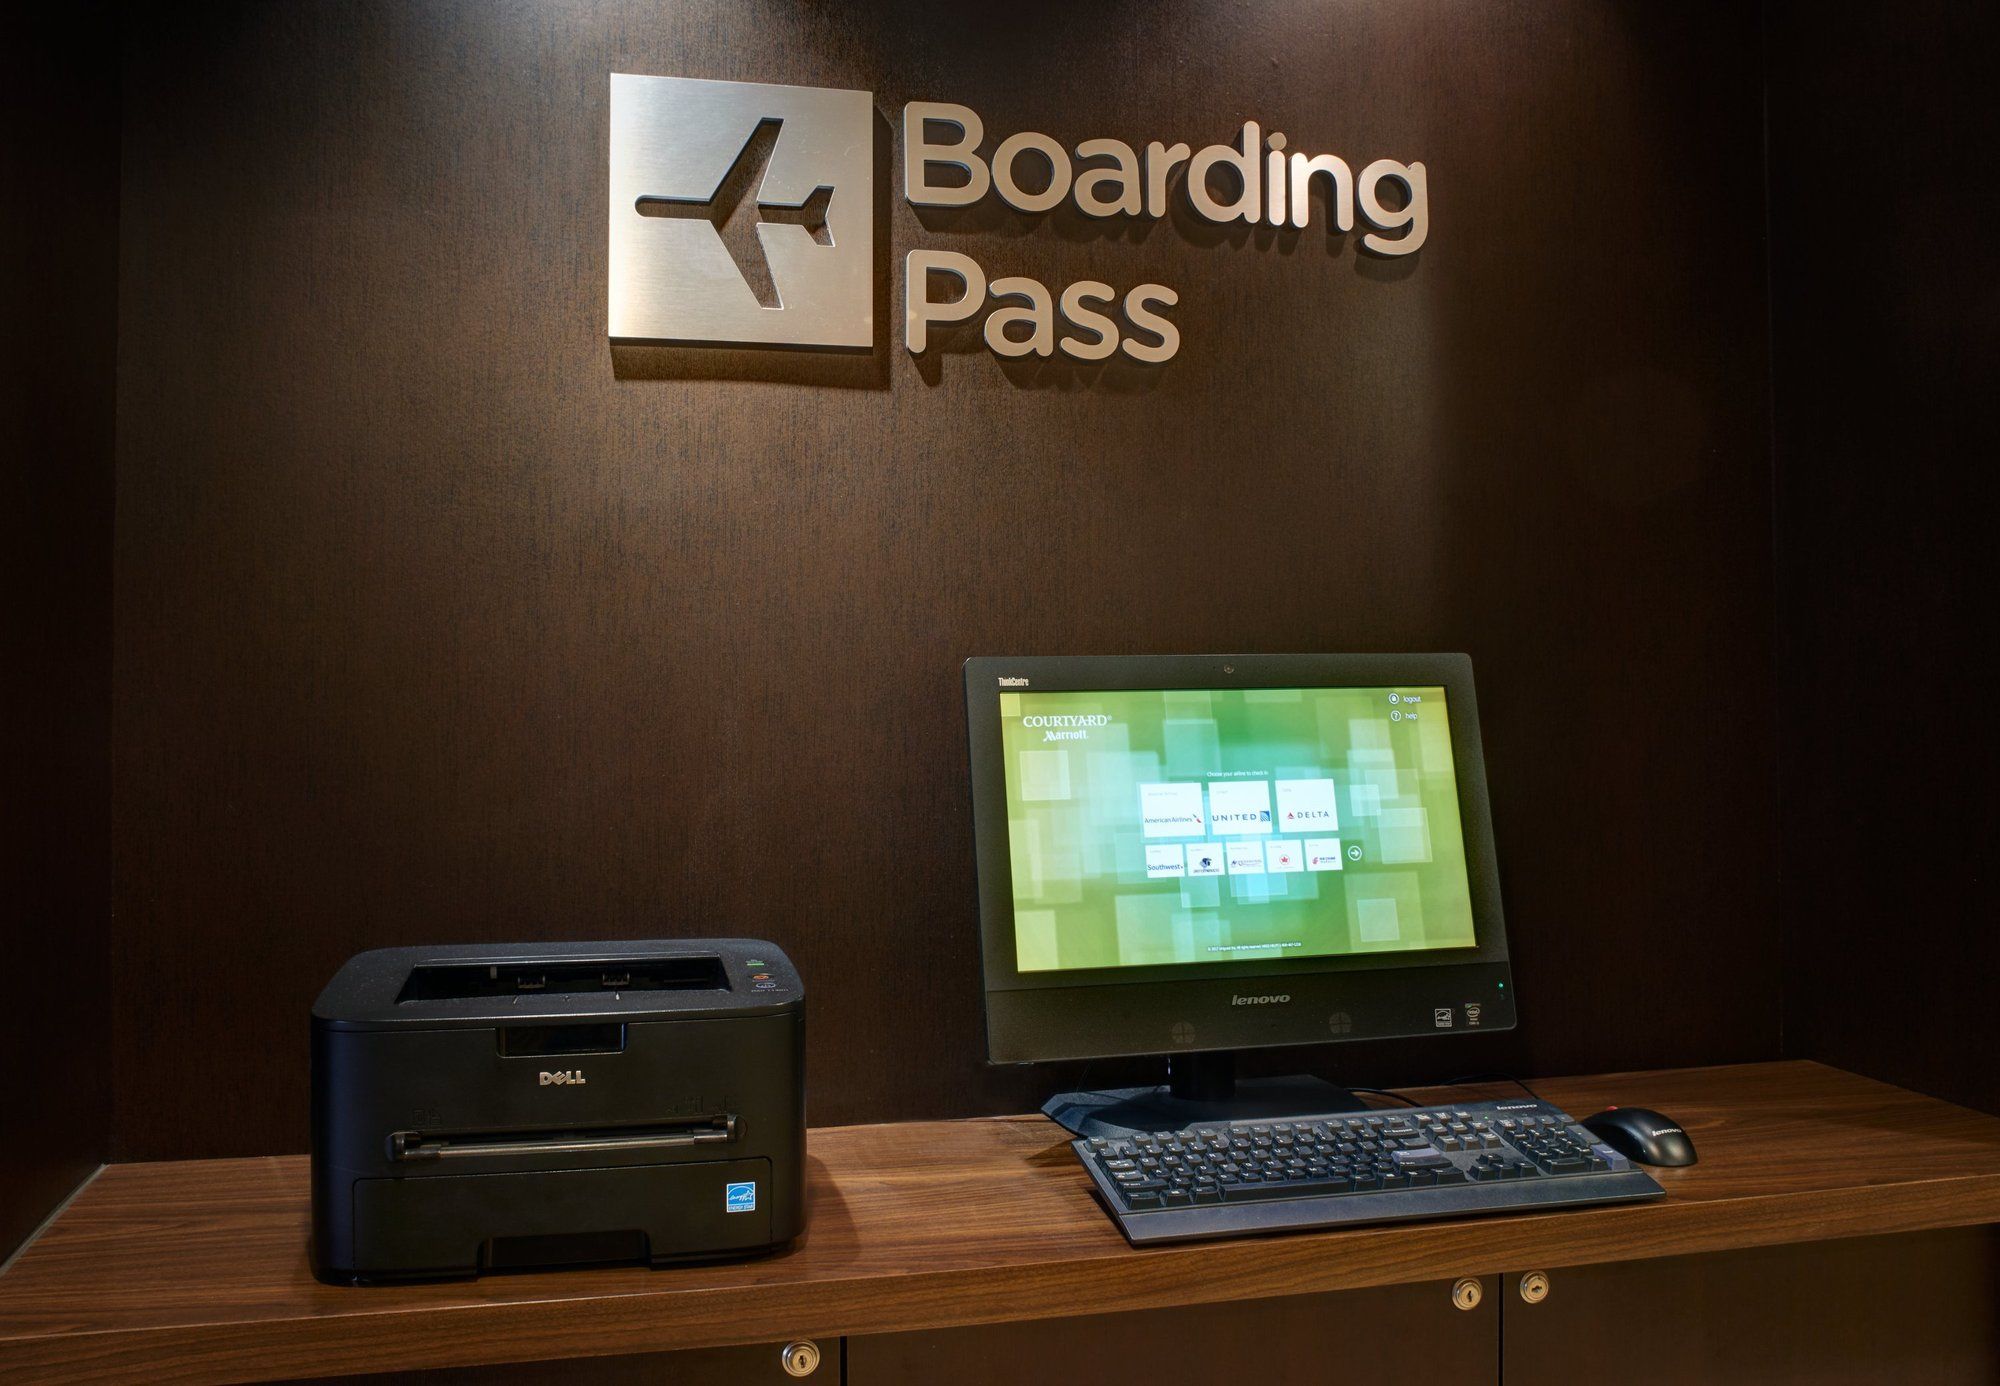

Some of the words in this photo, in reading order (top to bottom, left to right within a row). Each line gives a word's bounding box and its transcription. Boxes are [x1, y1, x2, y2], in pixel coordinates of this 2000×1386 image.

[903, 101, 1428, 256] Boarding
[905, 249, 1181, 363] Pass
[1405, 712, 1418, 720] help
[1212, 813, 1257, 822] UNITED
[1297, 811, 1330, 819] DELTA
[1231, 994, 1291, 1006] lenovo
[539, 1070, 586, 1086] DELL
[1651, 1128, 1682, 1137] lenovo
